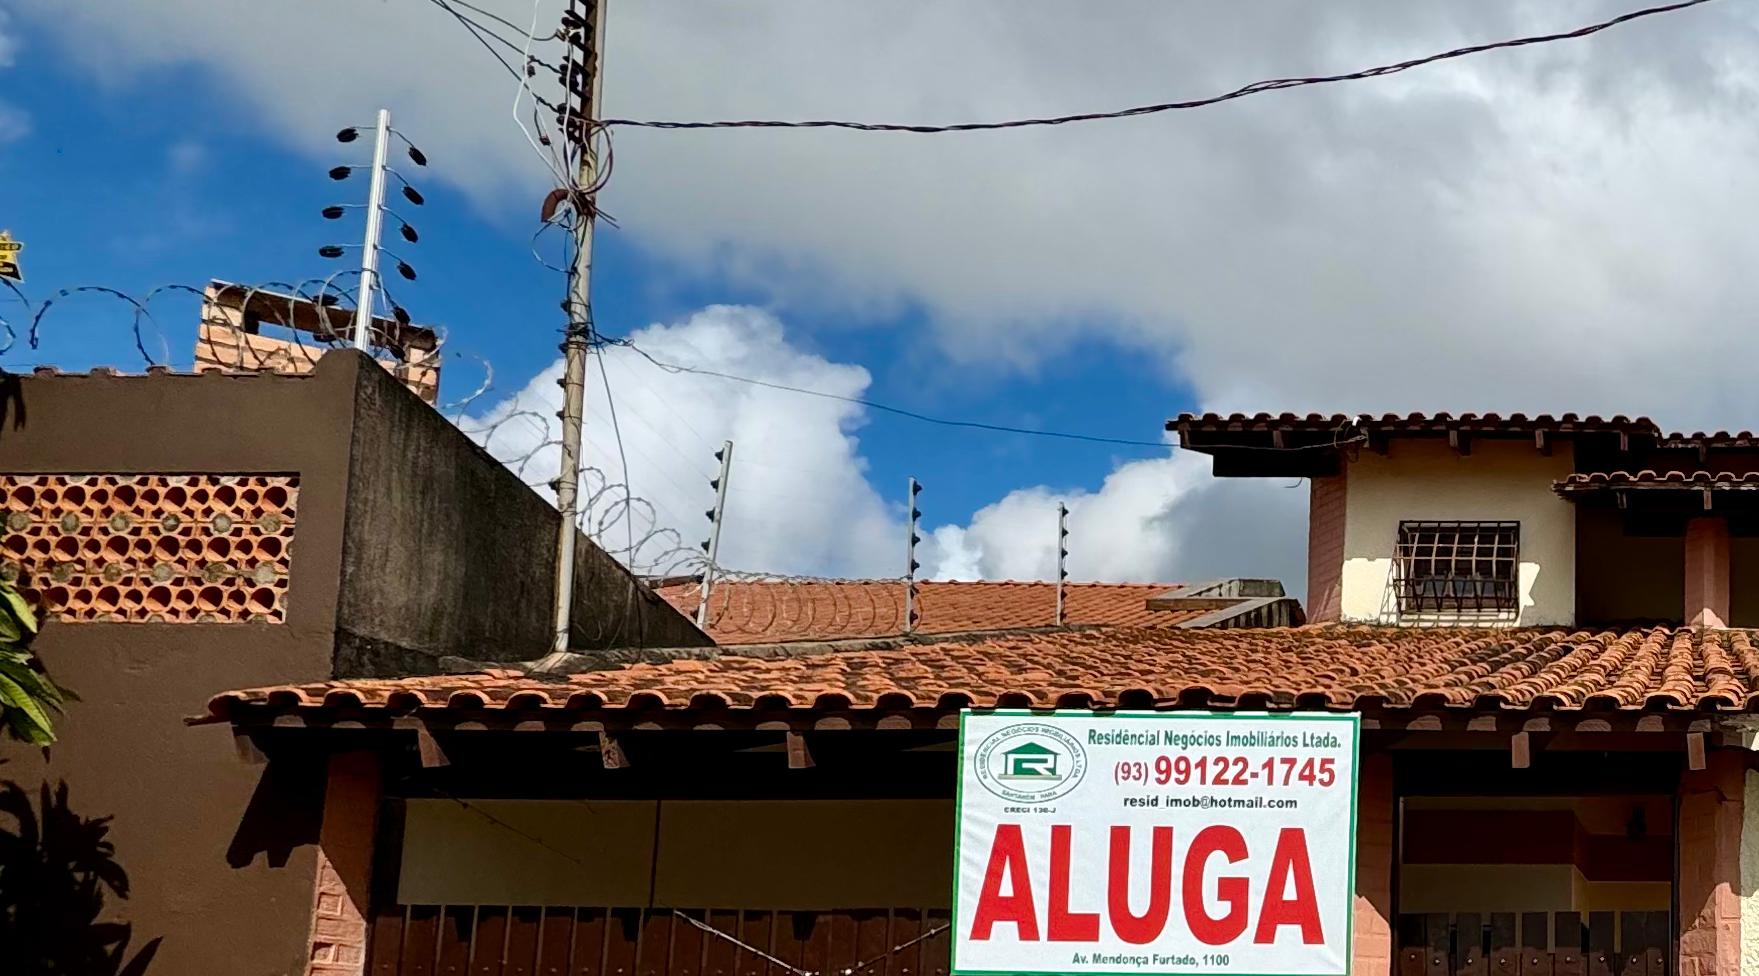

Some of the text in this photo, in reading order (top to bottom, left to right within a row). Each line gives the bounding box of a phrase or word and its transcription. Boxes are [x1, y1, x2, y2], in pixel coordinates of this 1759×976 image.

[1088, 729, 1342, 750] Residêncial Negócios Imobiliários Ltada.
[1114, 755, 1336, 787] (93) 99122-1745
[969, 824, 1325, 945] ALUGA
[1072, 952, 1230, 967] Av. Mendonça Furtado, 1100
